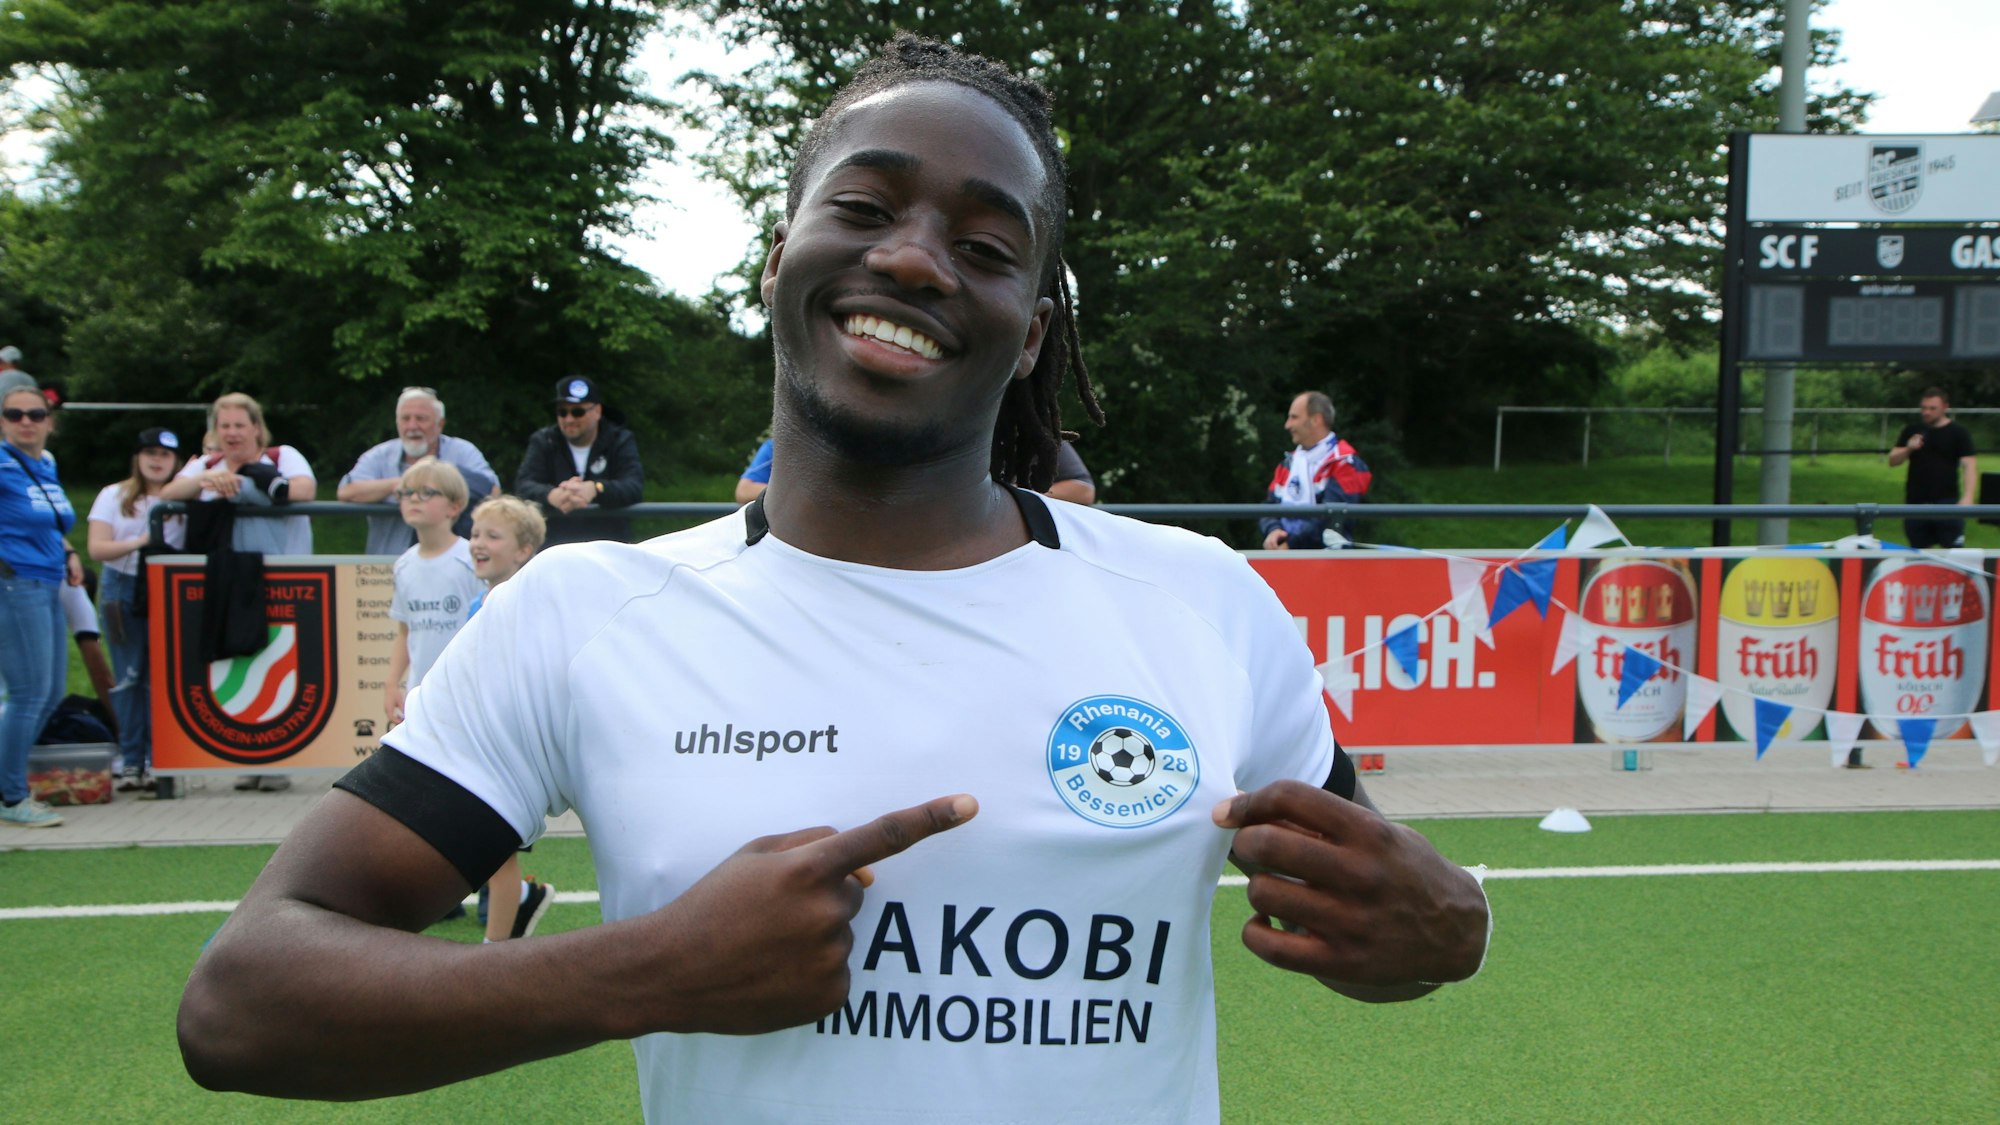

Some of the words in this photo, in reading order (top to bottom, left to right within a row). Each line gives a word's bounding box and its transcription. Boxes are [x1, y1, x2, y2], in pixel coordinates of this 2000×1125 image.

[1835, 181, 1863, 201] SEIT
[1592, 635, 1680, 683] frh
[1736, 635, 1818, 680] früh
[1874, 634, 1964, 681] früh
[190, 684, 318, 744] NORDRHEIN-WESTFALEN
[1068, 704, 1171, 739] Rhenania
[675, 723, 838, 761] uhlsport
[1057, 744, 1081, 760] 19
[1162, 755, 1188, 772] 28
[1066, 773, 1178, 817] Bessenich
[863, 901, 1171, 985] AKOBI
